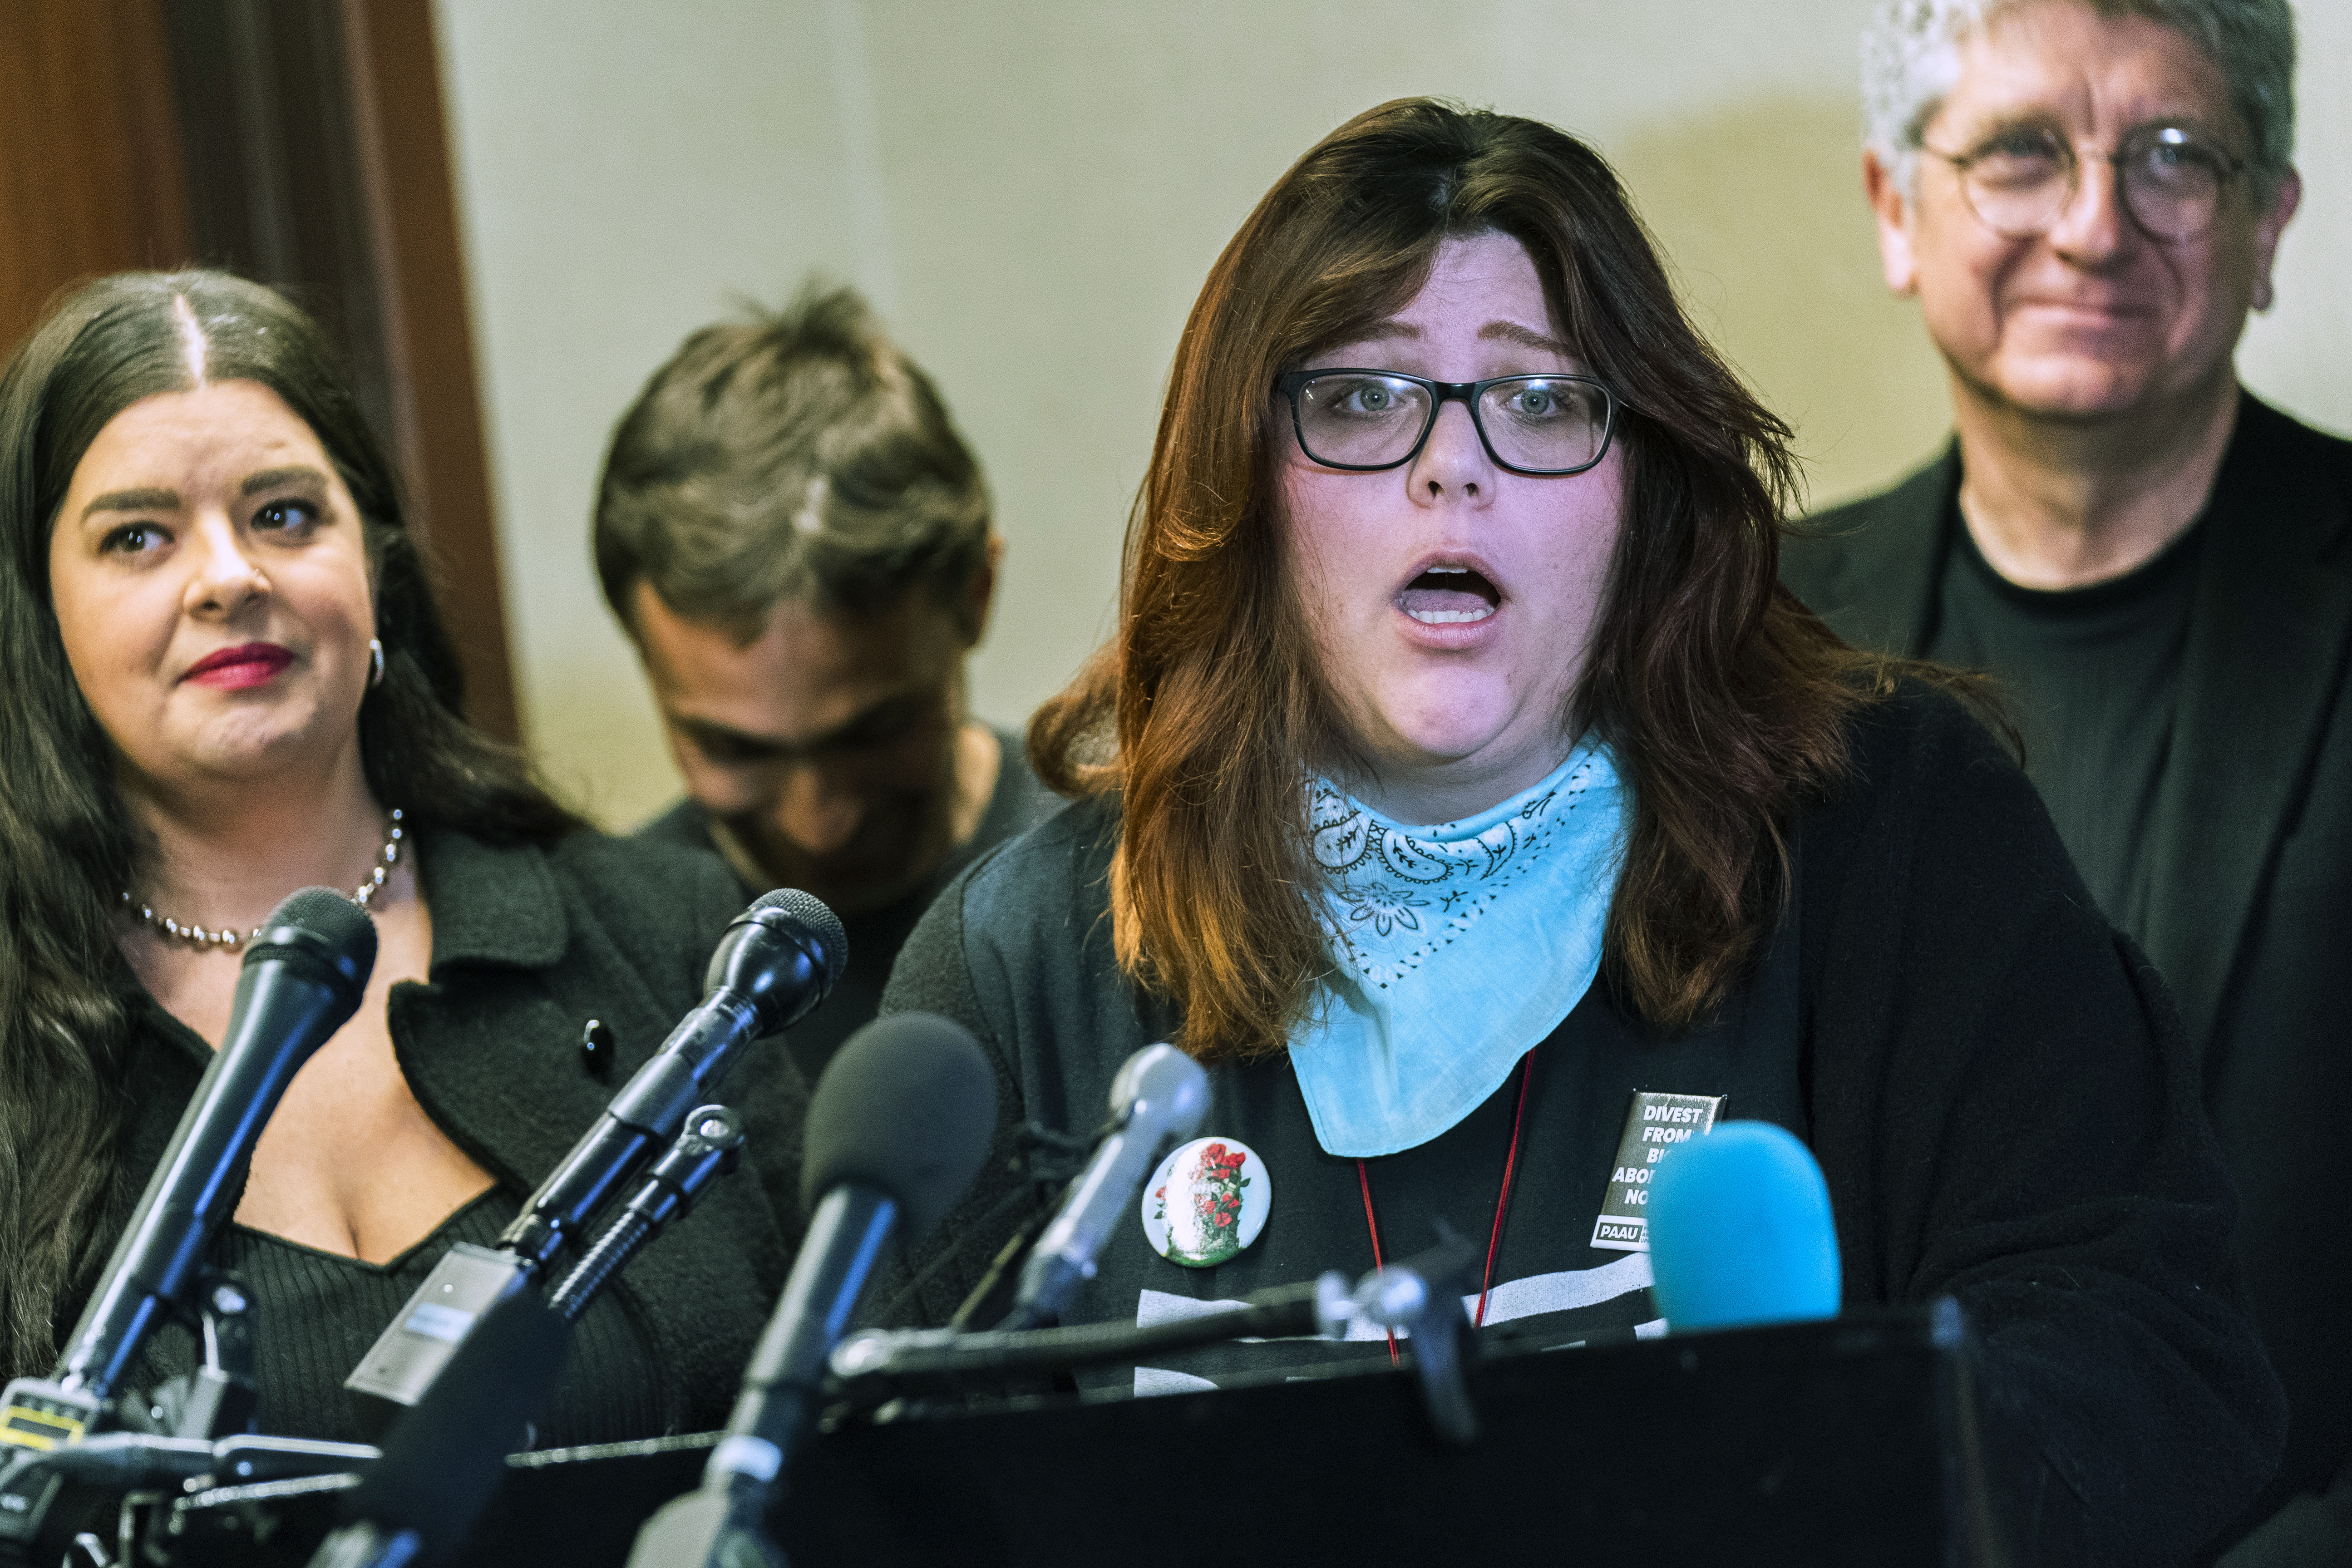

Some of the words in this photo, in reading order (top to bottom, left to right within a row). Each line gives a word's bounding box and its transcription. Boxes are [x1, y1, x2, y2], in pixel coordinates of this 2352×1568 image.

[1643, 1105, 1702, 1124] DIVEST
[1642, 1126, 1692, 1144] FROM
[1646, 1148, 1672, 1163] BI
[1624, 1188, 1649, 1205] NO
[1600, 1225, 1638, 1240] PAAU
